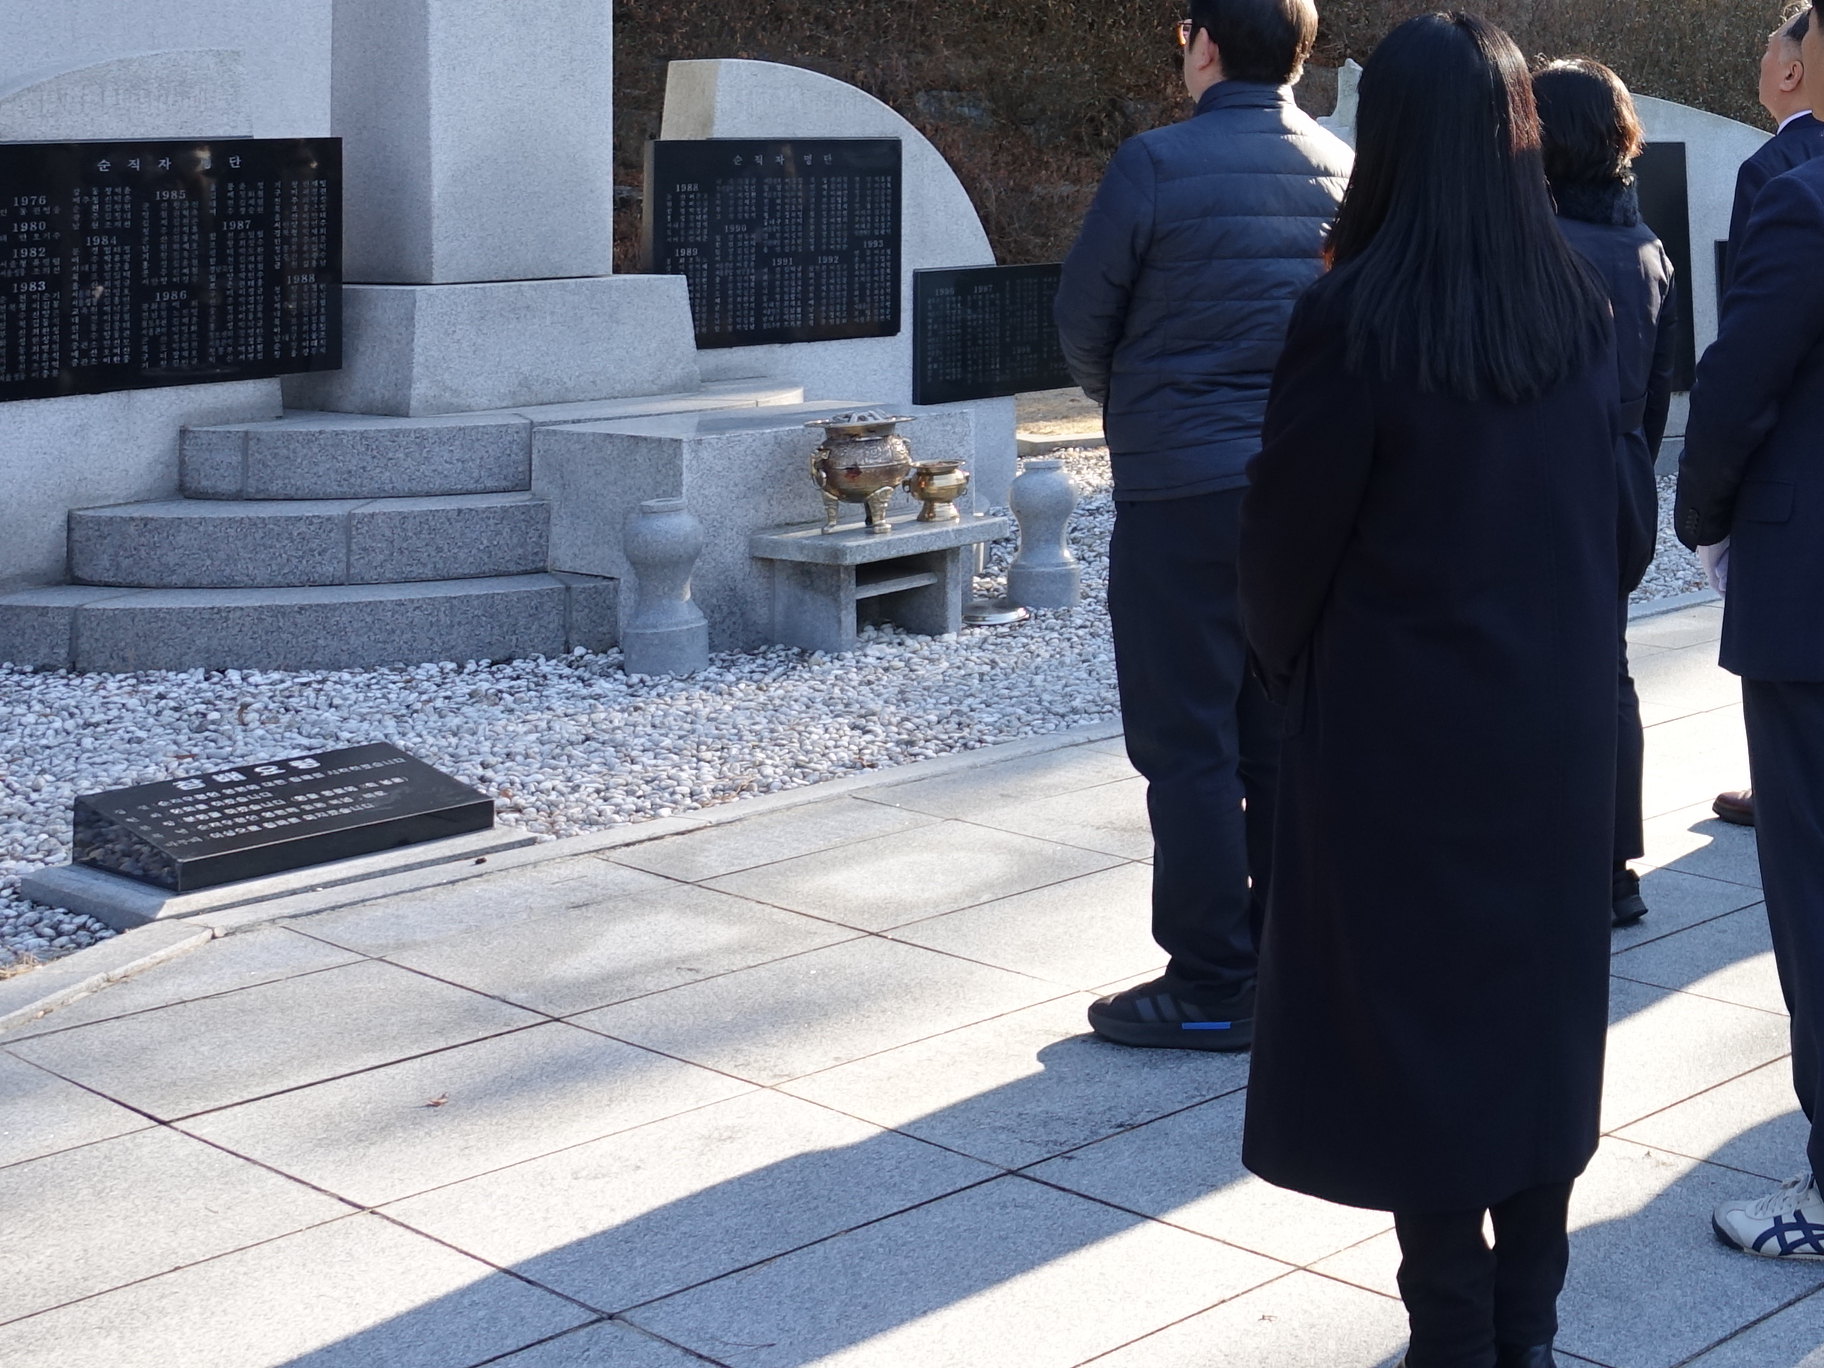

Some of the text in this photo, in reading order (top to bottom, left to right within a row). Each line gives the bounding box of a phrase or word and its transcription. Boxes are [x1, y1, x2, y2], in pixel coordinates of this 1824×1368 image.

[676, 183, 699, 193] 1988
[13, 195, 47, 207] 1976
[155, 189, 186, 201] 1985
[13, 221, 47, 232] 1980
[222, 220, 252, 231] 1987
[86, 235, 117, 246] 1984
[13, 247, 46, 259] 1982
[675, 248, 698, 257] 1989
[287, 273, 316, 285] 1988
[13, 281, 46, 293] 1983
[155, 290, 187, 302] 1986
